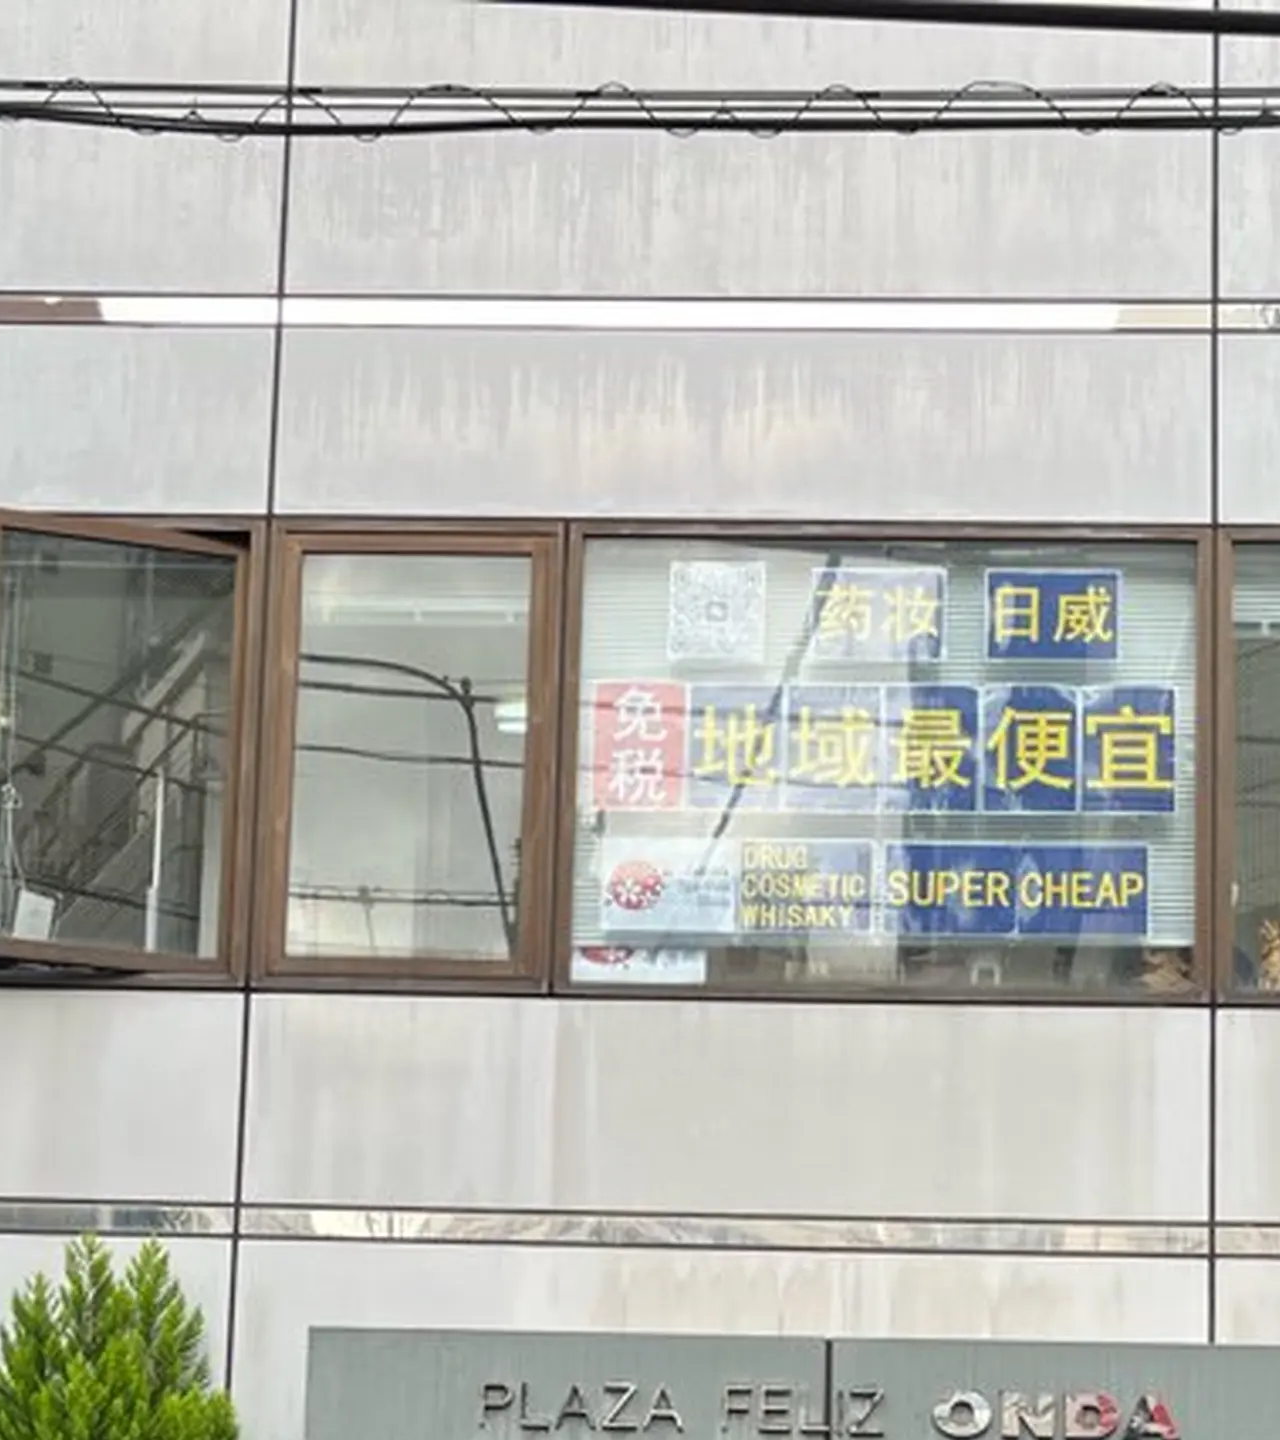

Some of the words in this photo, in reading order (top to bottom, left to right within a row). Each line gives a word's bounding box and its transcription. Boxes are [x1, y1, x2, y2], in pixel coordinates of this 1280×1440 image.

[815, 582, 940, 643] 药妆
[994, 585, 1114, 643] 日威
[692, 704, 1175, 792] 地域最便宜
[742, 872, 867, 899] COSMETIC
[888, 871, 1012, 909] SUPER
[1019, 870, 1145, 910] CHEAP
[480, 1381, 684, 1433] PLAZA
[722, 1382, 885, 1438] FELIZ
